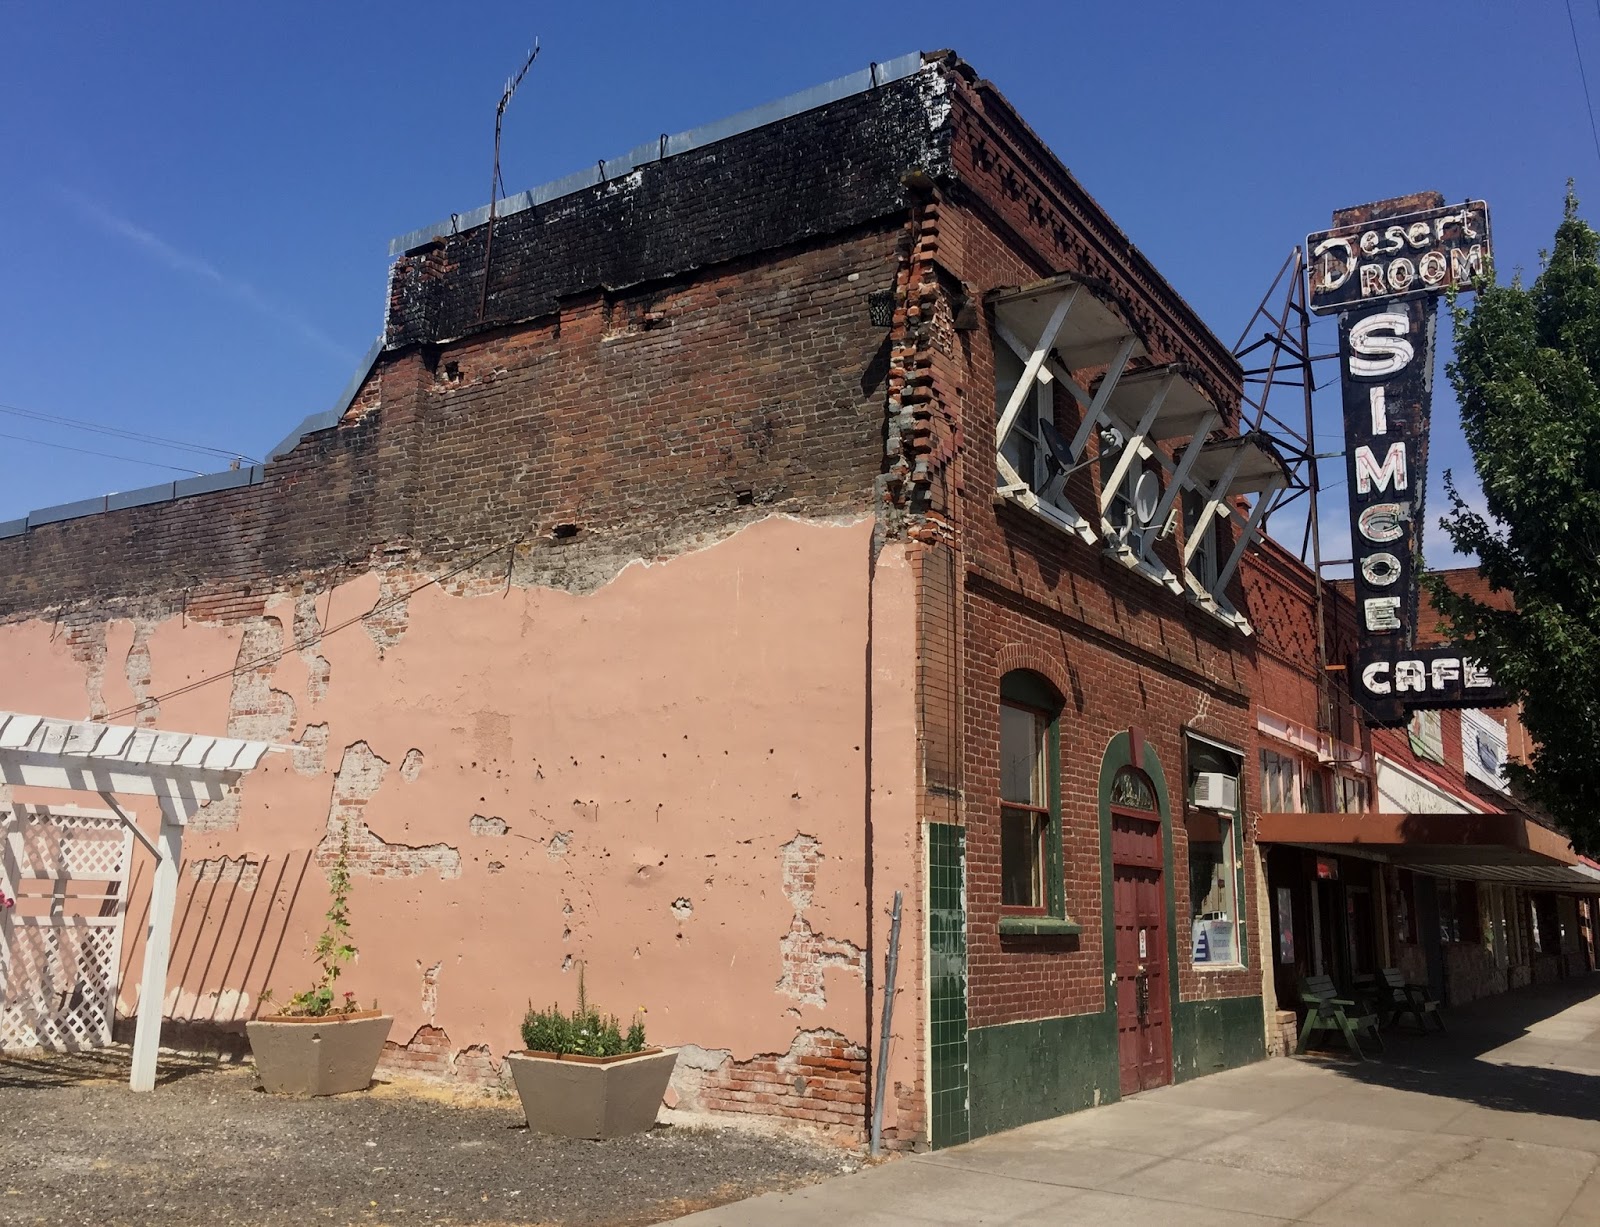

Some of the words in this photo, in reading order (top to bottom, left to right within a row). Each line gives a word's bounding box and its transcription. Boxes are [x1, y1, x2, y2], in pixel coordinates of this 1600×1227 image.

[1314, 209, 1478, 293] Desert
[1360, 244, 1484, 298] ROOM
[1349, 312, 1415, 632] SIMCOE
[1362, 656, 1493, 695] CAFE
